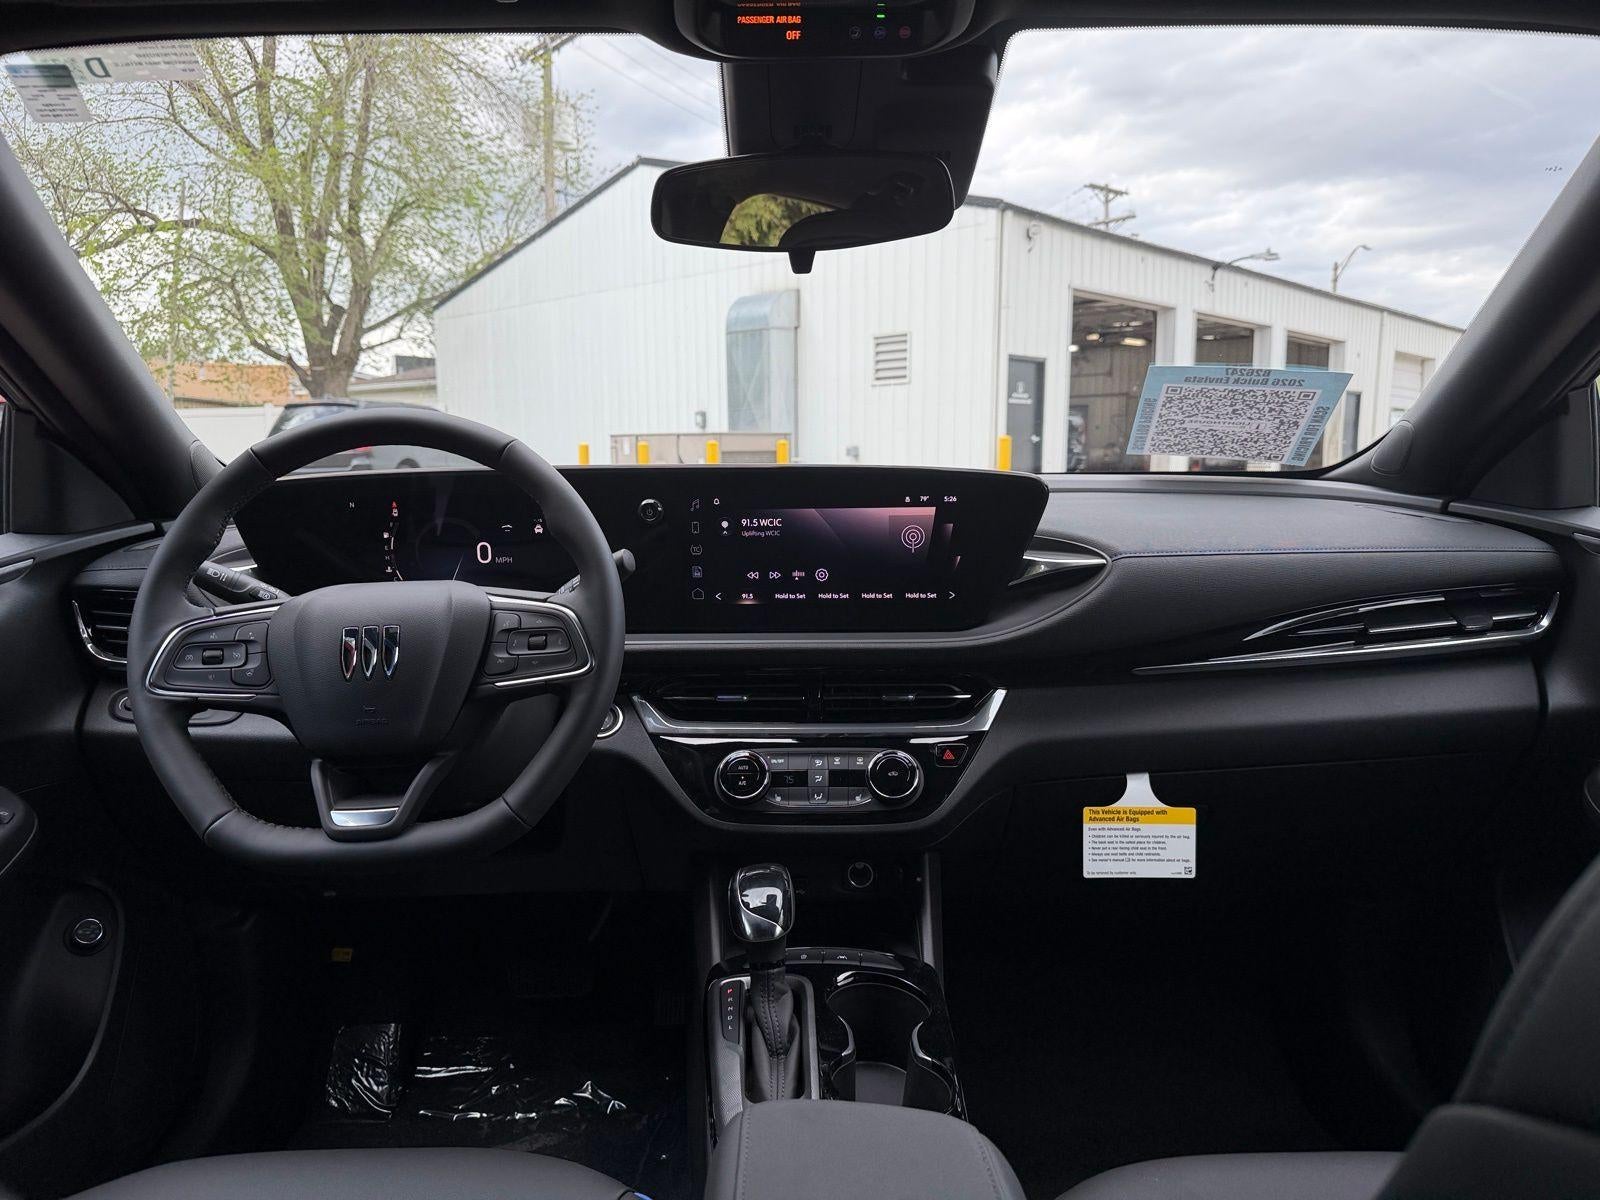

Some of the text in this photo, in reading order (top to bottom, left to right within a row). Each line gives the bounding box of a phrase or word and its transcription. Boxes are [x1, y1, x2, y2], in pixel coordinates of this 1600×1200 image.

[737, 15, 775, 24] PASSENGER
[785, 30, 801, 40] OFF
[741, 518, 782, 527] 91.5 WCIC
[476, 542, 513, 564] 0 MPH
[1088, 808, 1168, 816] This Vehicle is Equipped with
